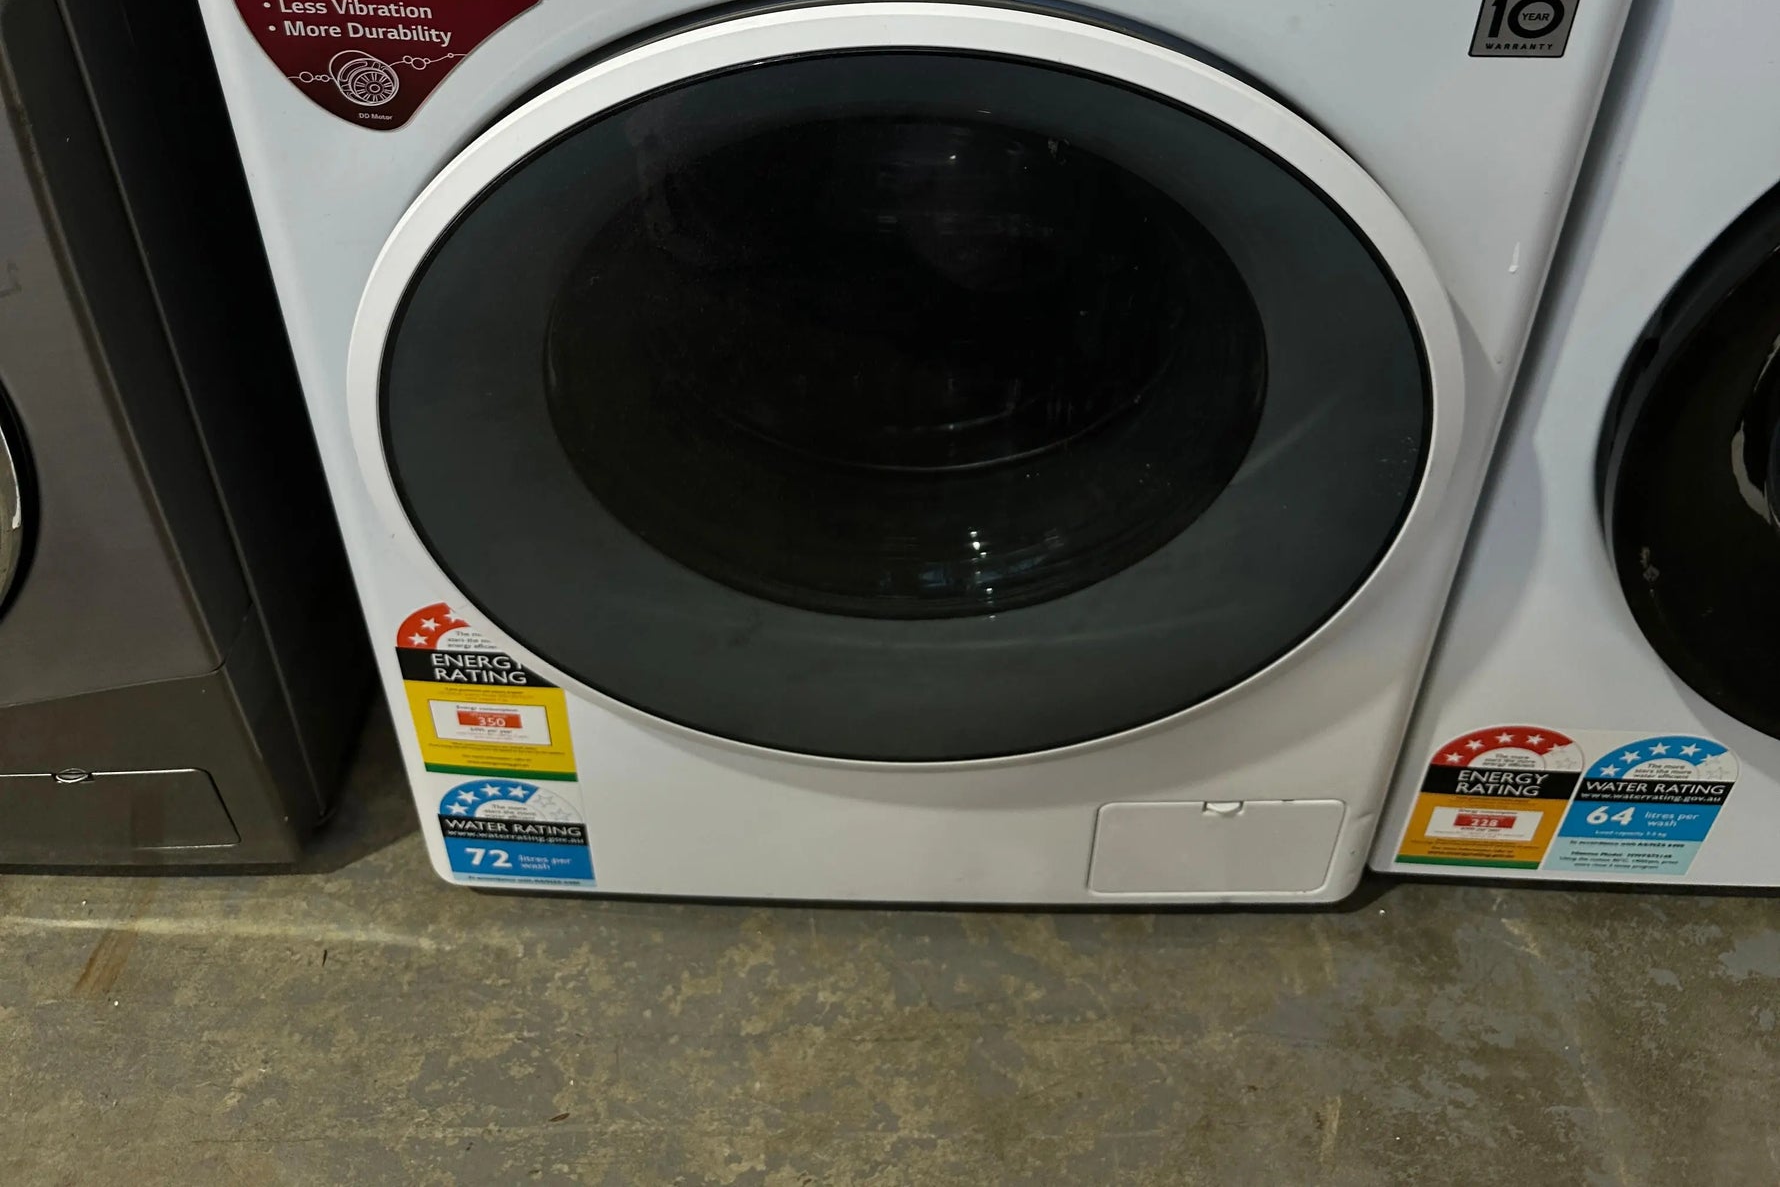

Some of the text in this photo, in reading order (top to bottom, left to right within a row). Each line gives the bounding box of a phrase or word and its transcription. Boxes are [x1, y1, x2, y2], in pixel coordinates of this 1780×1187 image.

[1522, 12, 1551, 21] YEAR
[284, 20, 452, 48] More Durability
[1485, 43, 1553, 51] WARRANTY
[371, 112, 393, 120] Motor
[434, 667, 527, 684] RATING
[478, 716, 506, 727] 350
[1457, 769, 1549, 785] ENERGY
[1455, 782, 1542, 797] RATING
[1586, 780, 1726, 795] WATER RATING
[1581, 792, 1722, 803] www.waterrating.gov.au
[1586, 806, 1700, 826] 64 litres per
[1647, 819, 1678, 828] wash
[445, 818, 582, 837] WATER RATING
[464, 847, 572, 869] 72 litres per
